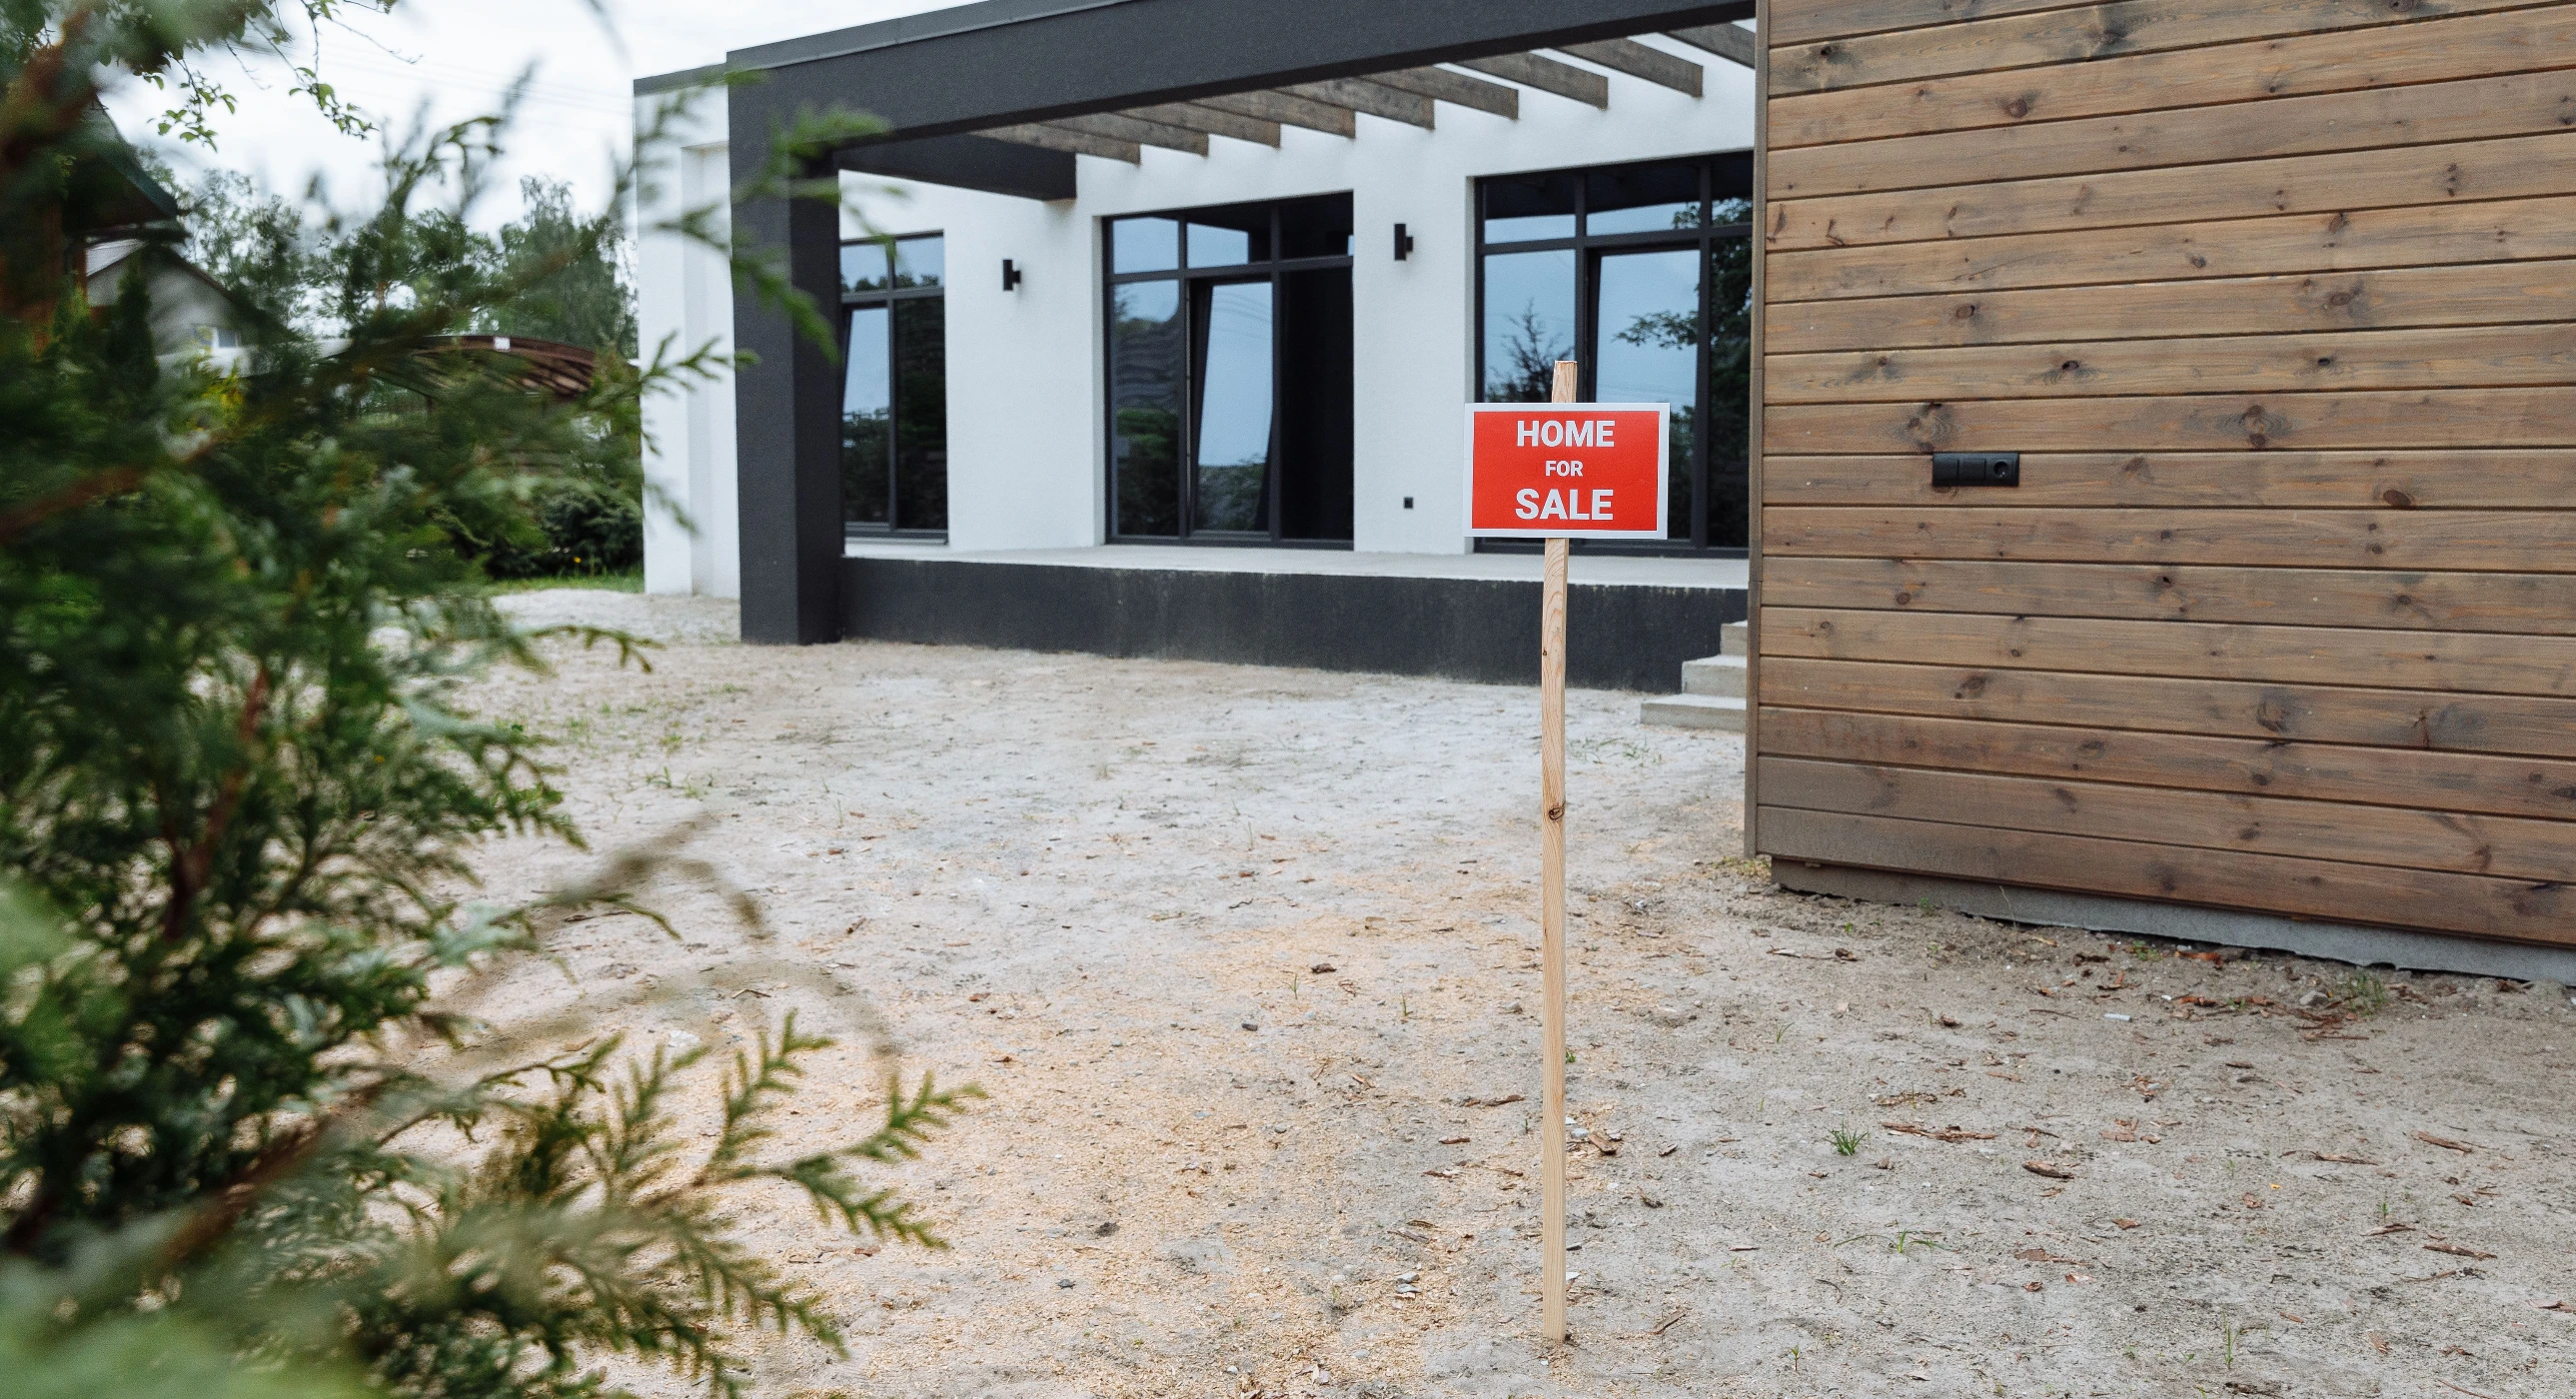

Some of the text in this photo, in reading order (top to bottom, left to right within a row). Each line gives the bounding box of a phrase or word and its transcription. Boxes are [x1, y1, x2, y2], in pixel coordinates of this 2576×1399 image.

[1517, 420, 1616, 448] HOME
[1545, 460, 1584, 477] FOR
[1515, 488, 1614, 521] SALE
